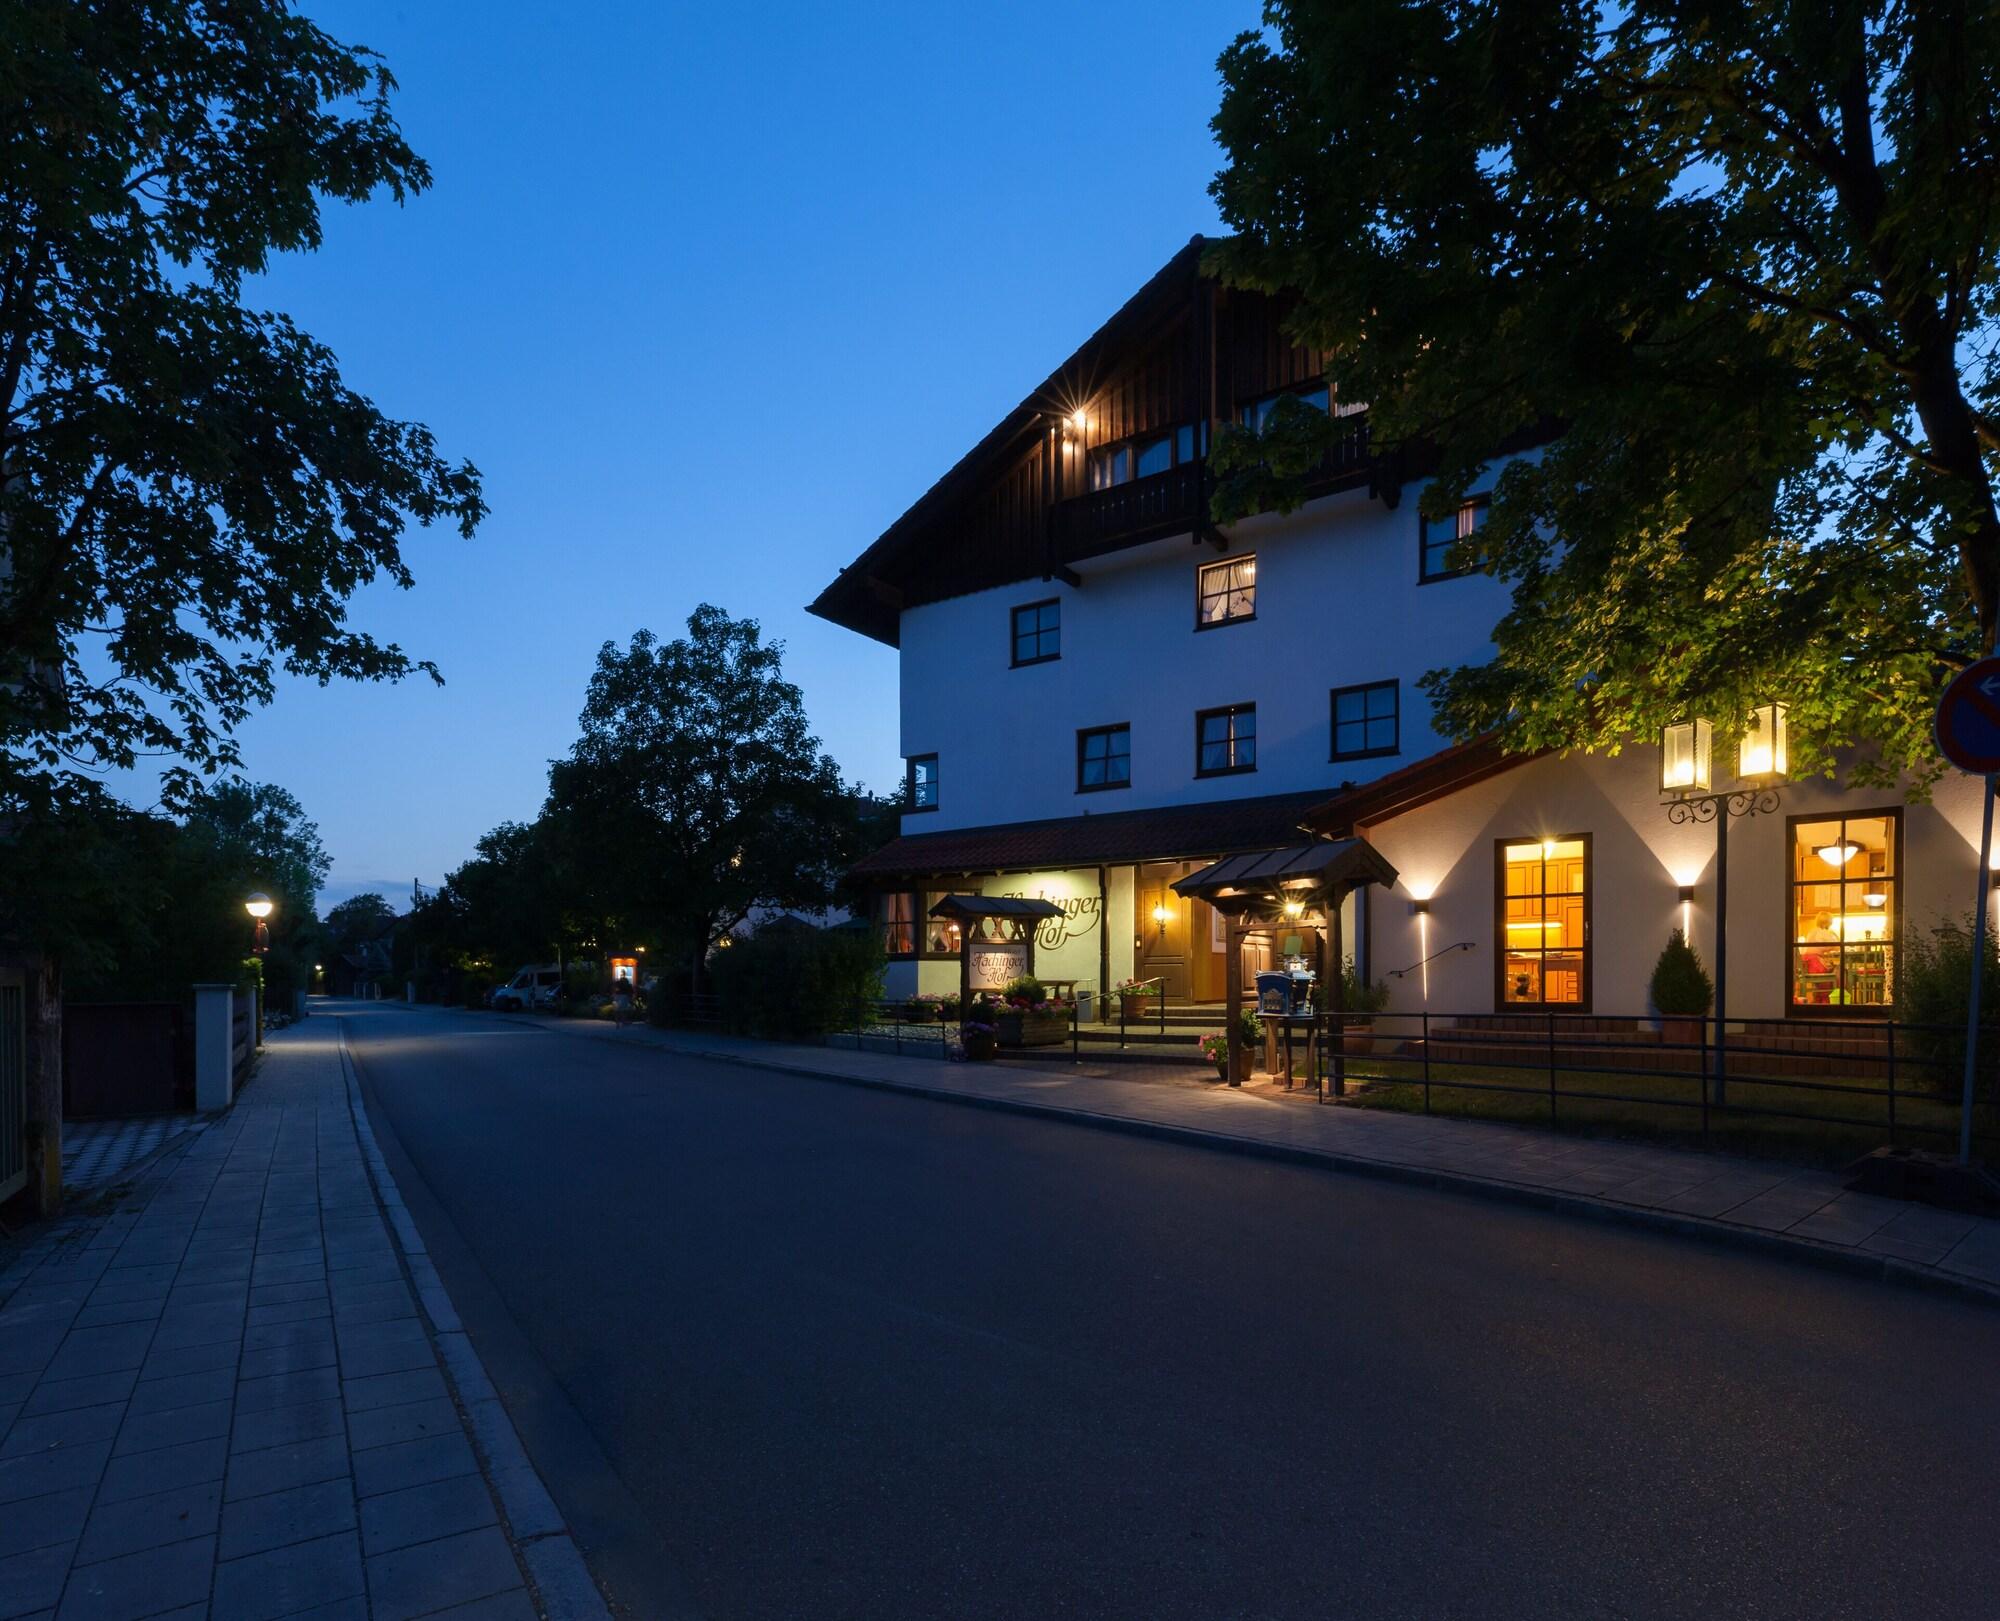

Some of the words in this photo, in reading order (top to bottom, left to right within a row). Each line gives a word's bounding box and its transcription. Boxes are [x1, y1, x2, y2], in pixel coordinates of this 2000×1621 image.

[1002, 890, 1101, 922] inger
[1033, 918, 1068, 950] Hof
[971, 952, 1025, 973] Hachinger
[987, 967, 1009, 986] Hof
